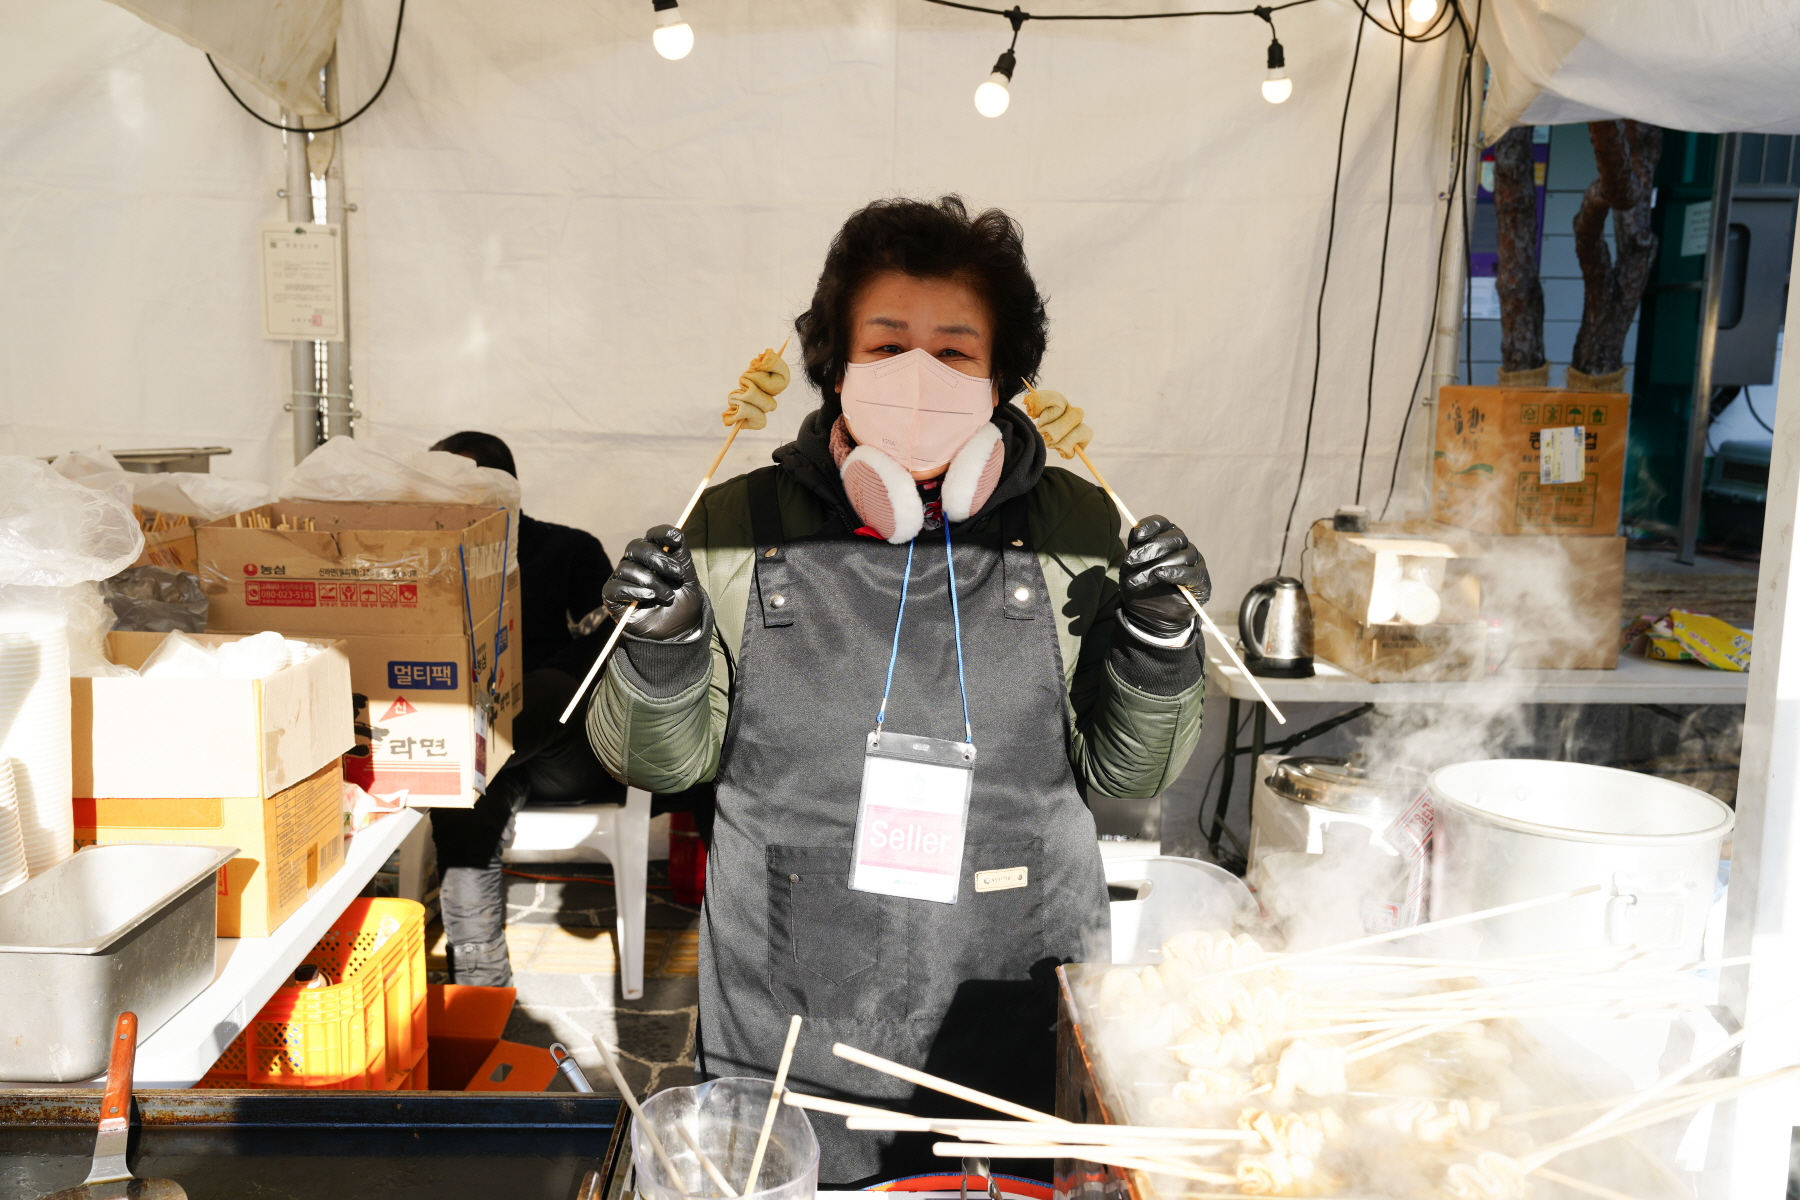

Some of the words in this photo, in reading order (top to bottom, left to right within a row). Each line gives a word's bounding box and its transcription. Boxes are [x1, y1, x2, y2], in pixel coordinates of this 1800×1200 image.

[260, 564, 286, 575] 농심
[261, 590, 315, 600] 080-023-5181
[394, 665, 451, 686] 멀티팩
[394, 701, 407, 715] 신
[389, 736, 448, 760] 라면
[869, 819, 954, 856] Seller
